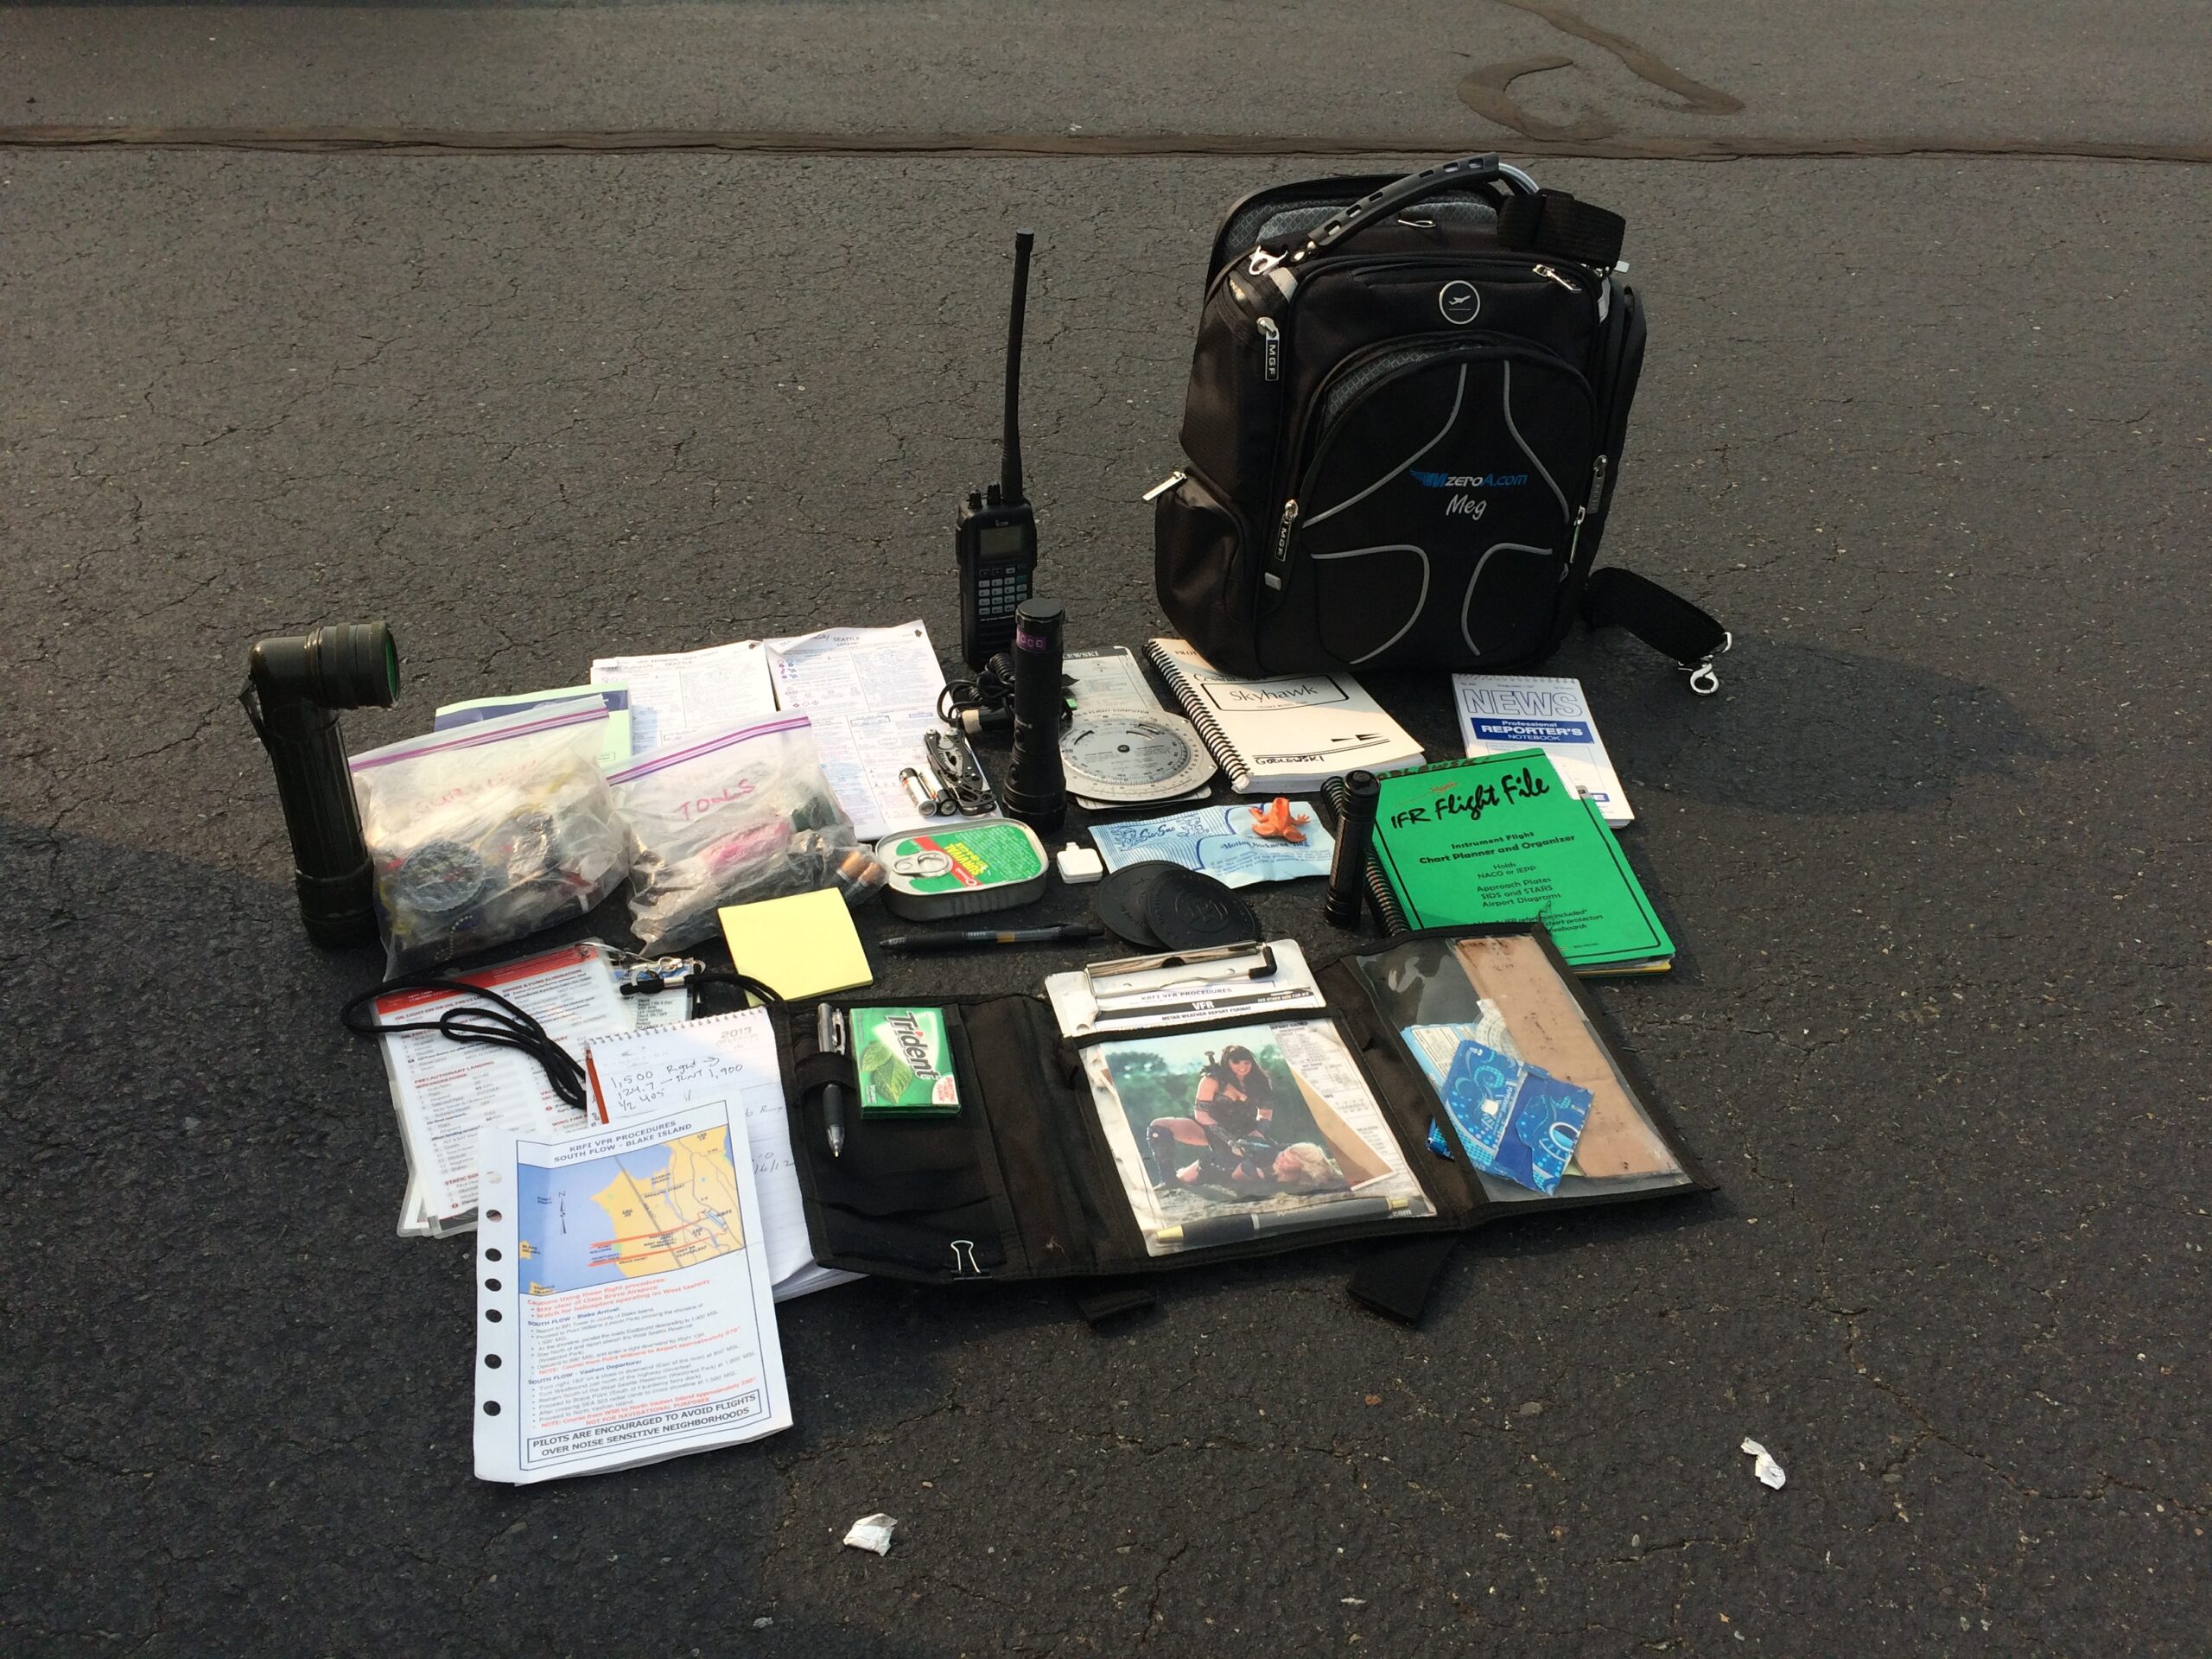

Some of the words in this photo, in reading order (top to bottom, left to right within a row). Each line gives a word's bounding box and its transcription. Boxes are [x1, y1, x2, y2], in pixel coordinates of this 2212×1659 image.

[1446, 493, 1487, 520] Meg
[1229, 684, 1319, 703] Skyhawk
[1463, 689, 1582, 718] NEWS
[1481, 725, 1584, 736] REPORTER'S
[1390, 808, 1431, 829] IFR
[1435, 785, 1500, 820] Flight
[1501, 767, 1550, 804] File
[1420, 855, 1452, 864] Chart
[1452, 848, 1496, 860] Planner
[1497, 843, 1519, 853] and
[1522, 835, 1575, 849] Organizer
[1452, 836, 1503, 850] Instrument
[1506, 831, 1535, 842] Flight
[1477, 871, 1503, 880] NACO
[1477, 880, 1522, 893] Approach
[1522, 877, 1552, 886] Plates
[1482, 899, 1515, 908] Airport
[1516, 892, 1562, 905] Diagrams
[1523, 885, 1554, 894] STARS
[1192, 1001, 1215, 1011] VFR
[885, 1011, 940, 1080] Trident
[554, 1151, 588, 1162] SOUTH
[588, 1145, 616, 1157] FLOW
[626, 1135, 655, 1151] BLAKE
[657, 1123, 692, 1139] ISLAND
[569, 1142, 592, 1152] KBFI
[594, 1138, 613, 1147] VFR
[615, 1120, 676, 1142] PROCEDURES
[527, 1319, 550, 1328] SOUTH
[527, 1376, 551, 1385] SOUTH
[606, 1359, 641, 1370] Departure:
[532, 1434, 569, 1448] PILOTS
[572, 1430, 592, 1440] ARE
[594, 1416, 663, 1435] ENCOURAGED
[664, 1412, 678, 1421] TO
[681, 1406, 714, 1420] AVOID
[715, 1393, 756, 1412] FLIGHTS
[541, 1446, 569, 1457] OVER
[572, 1438, 604, 1451] NOISE
[606, 1427, 660, 1444] SENSITIVE
[662, 1407, 750, 1433] NEIGHBORHOODS
